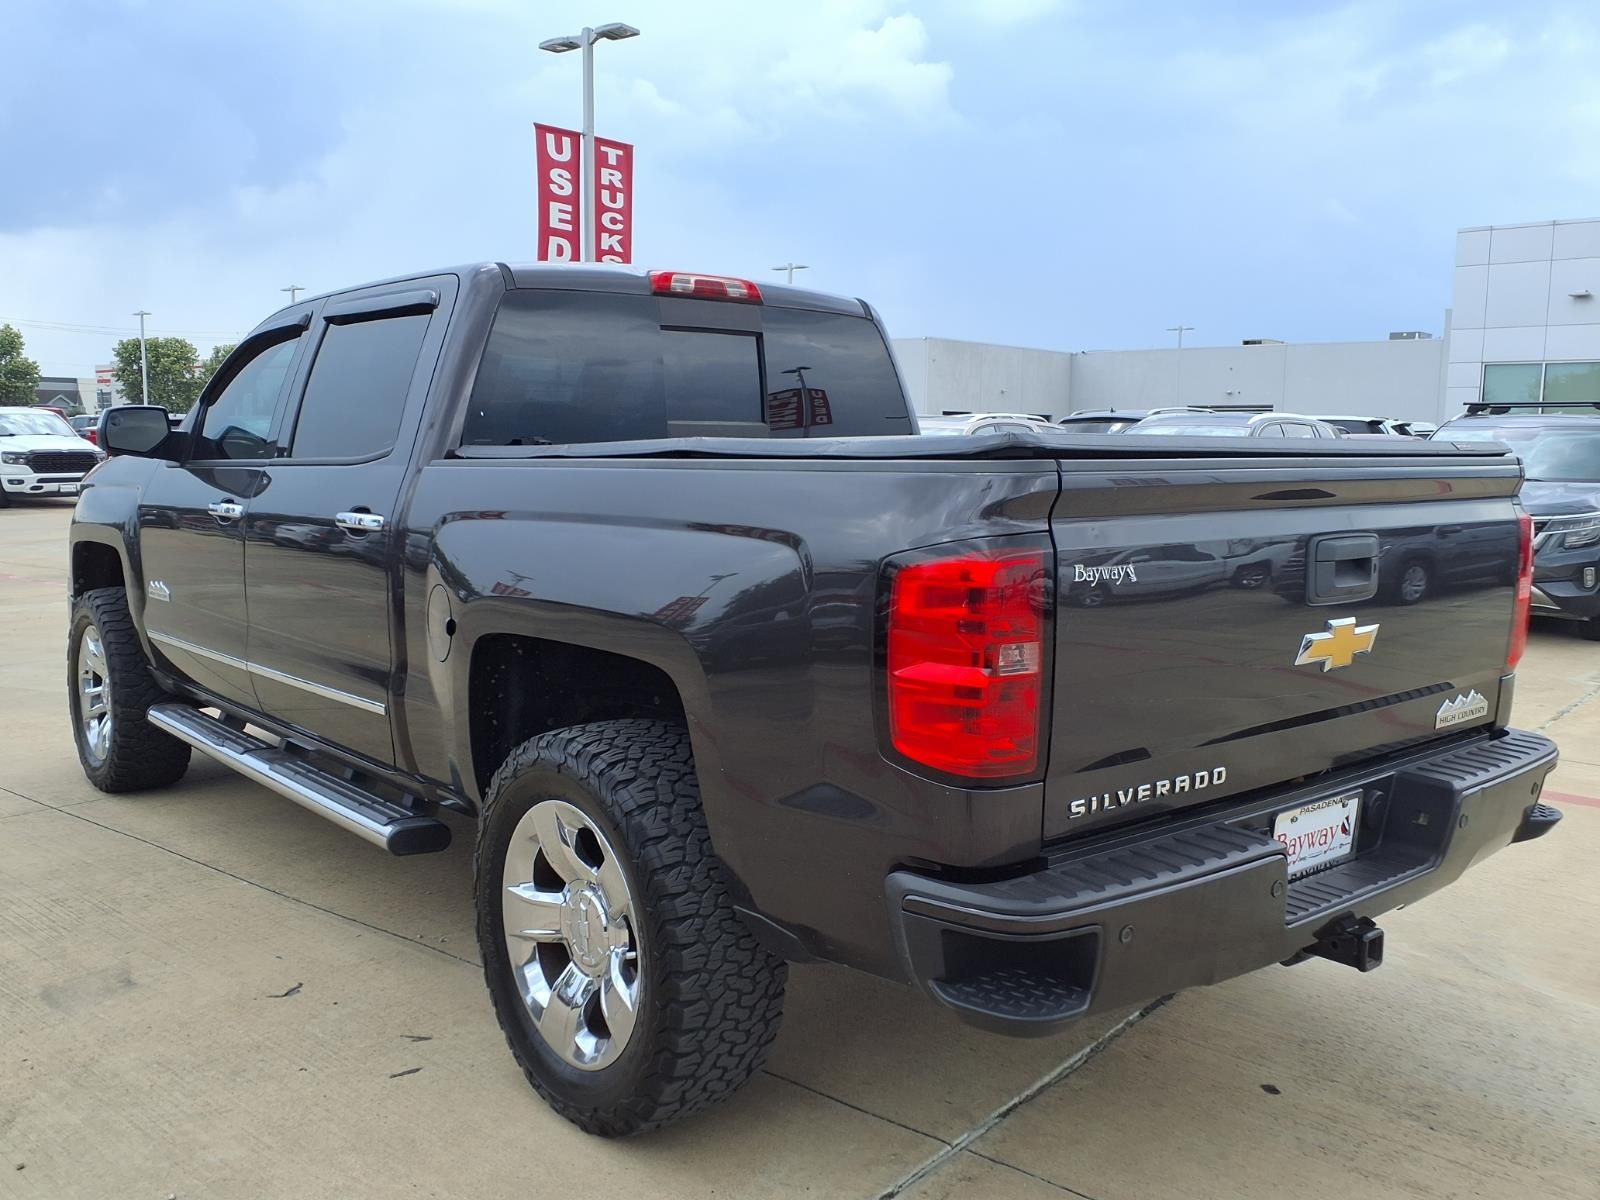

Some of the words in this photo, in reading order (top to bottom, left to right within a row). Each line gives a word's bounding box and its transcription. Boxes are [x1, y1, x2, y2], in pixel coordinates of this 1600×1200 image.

[546, 132, 573, 262] USED
[1073, 564, 1127, 587] Bayway
[1439, 714, 1456, 725] HIGH
[1068, 766, 1227, 819] SILVERADO
[1300, 798, 1344, 815] PASADENA
